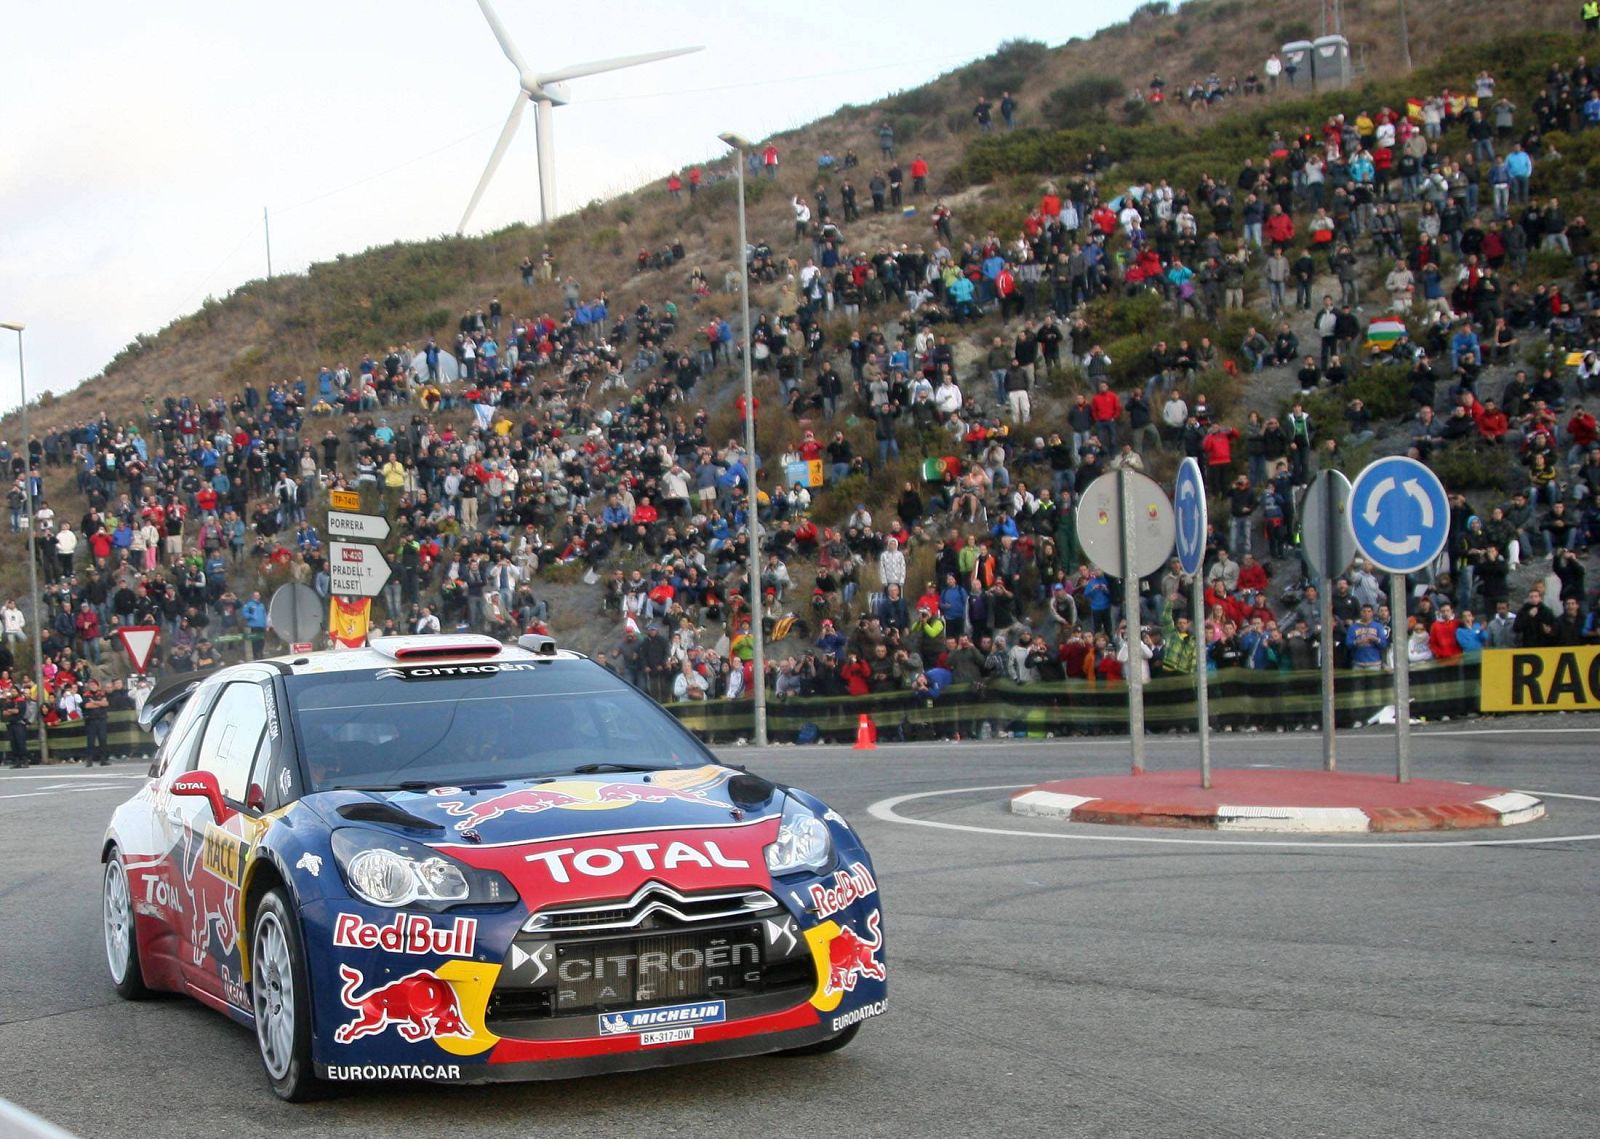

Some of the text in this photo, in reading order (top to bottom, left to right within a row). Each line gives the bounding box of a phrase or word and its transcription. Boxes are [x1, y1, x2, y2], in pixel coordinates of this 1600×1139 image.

[330, 518, 364, 531] PORRERA
[332, 565, 364, 577] PRADELL
[333, 579, 360, 591] FALSET
[175, 782, 207, 790] TOTAL
[206, 831, 236, 879] RACC
[525, 841, 750, 883] TOTAL
[141, 874, 183, 913] TOTAL
[632, 1005, 719, 1026] MICHELIN
[643, 1029, 692, 1044] BK-317-DW
[327, 1064, 461, 1081] EURODATACAR
